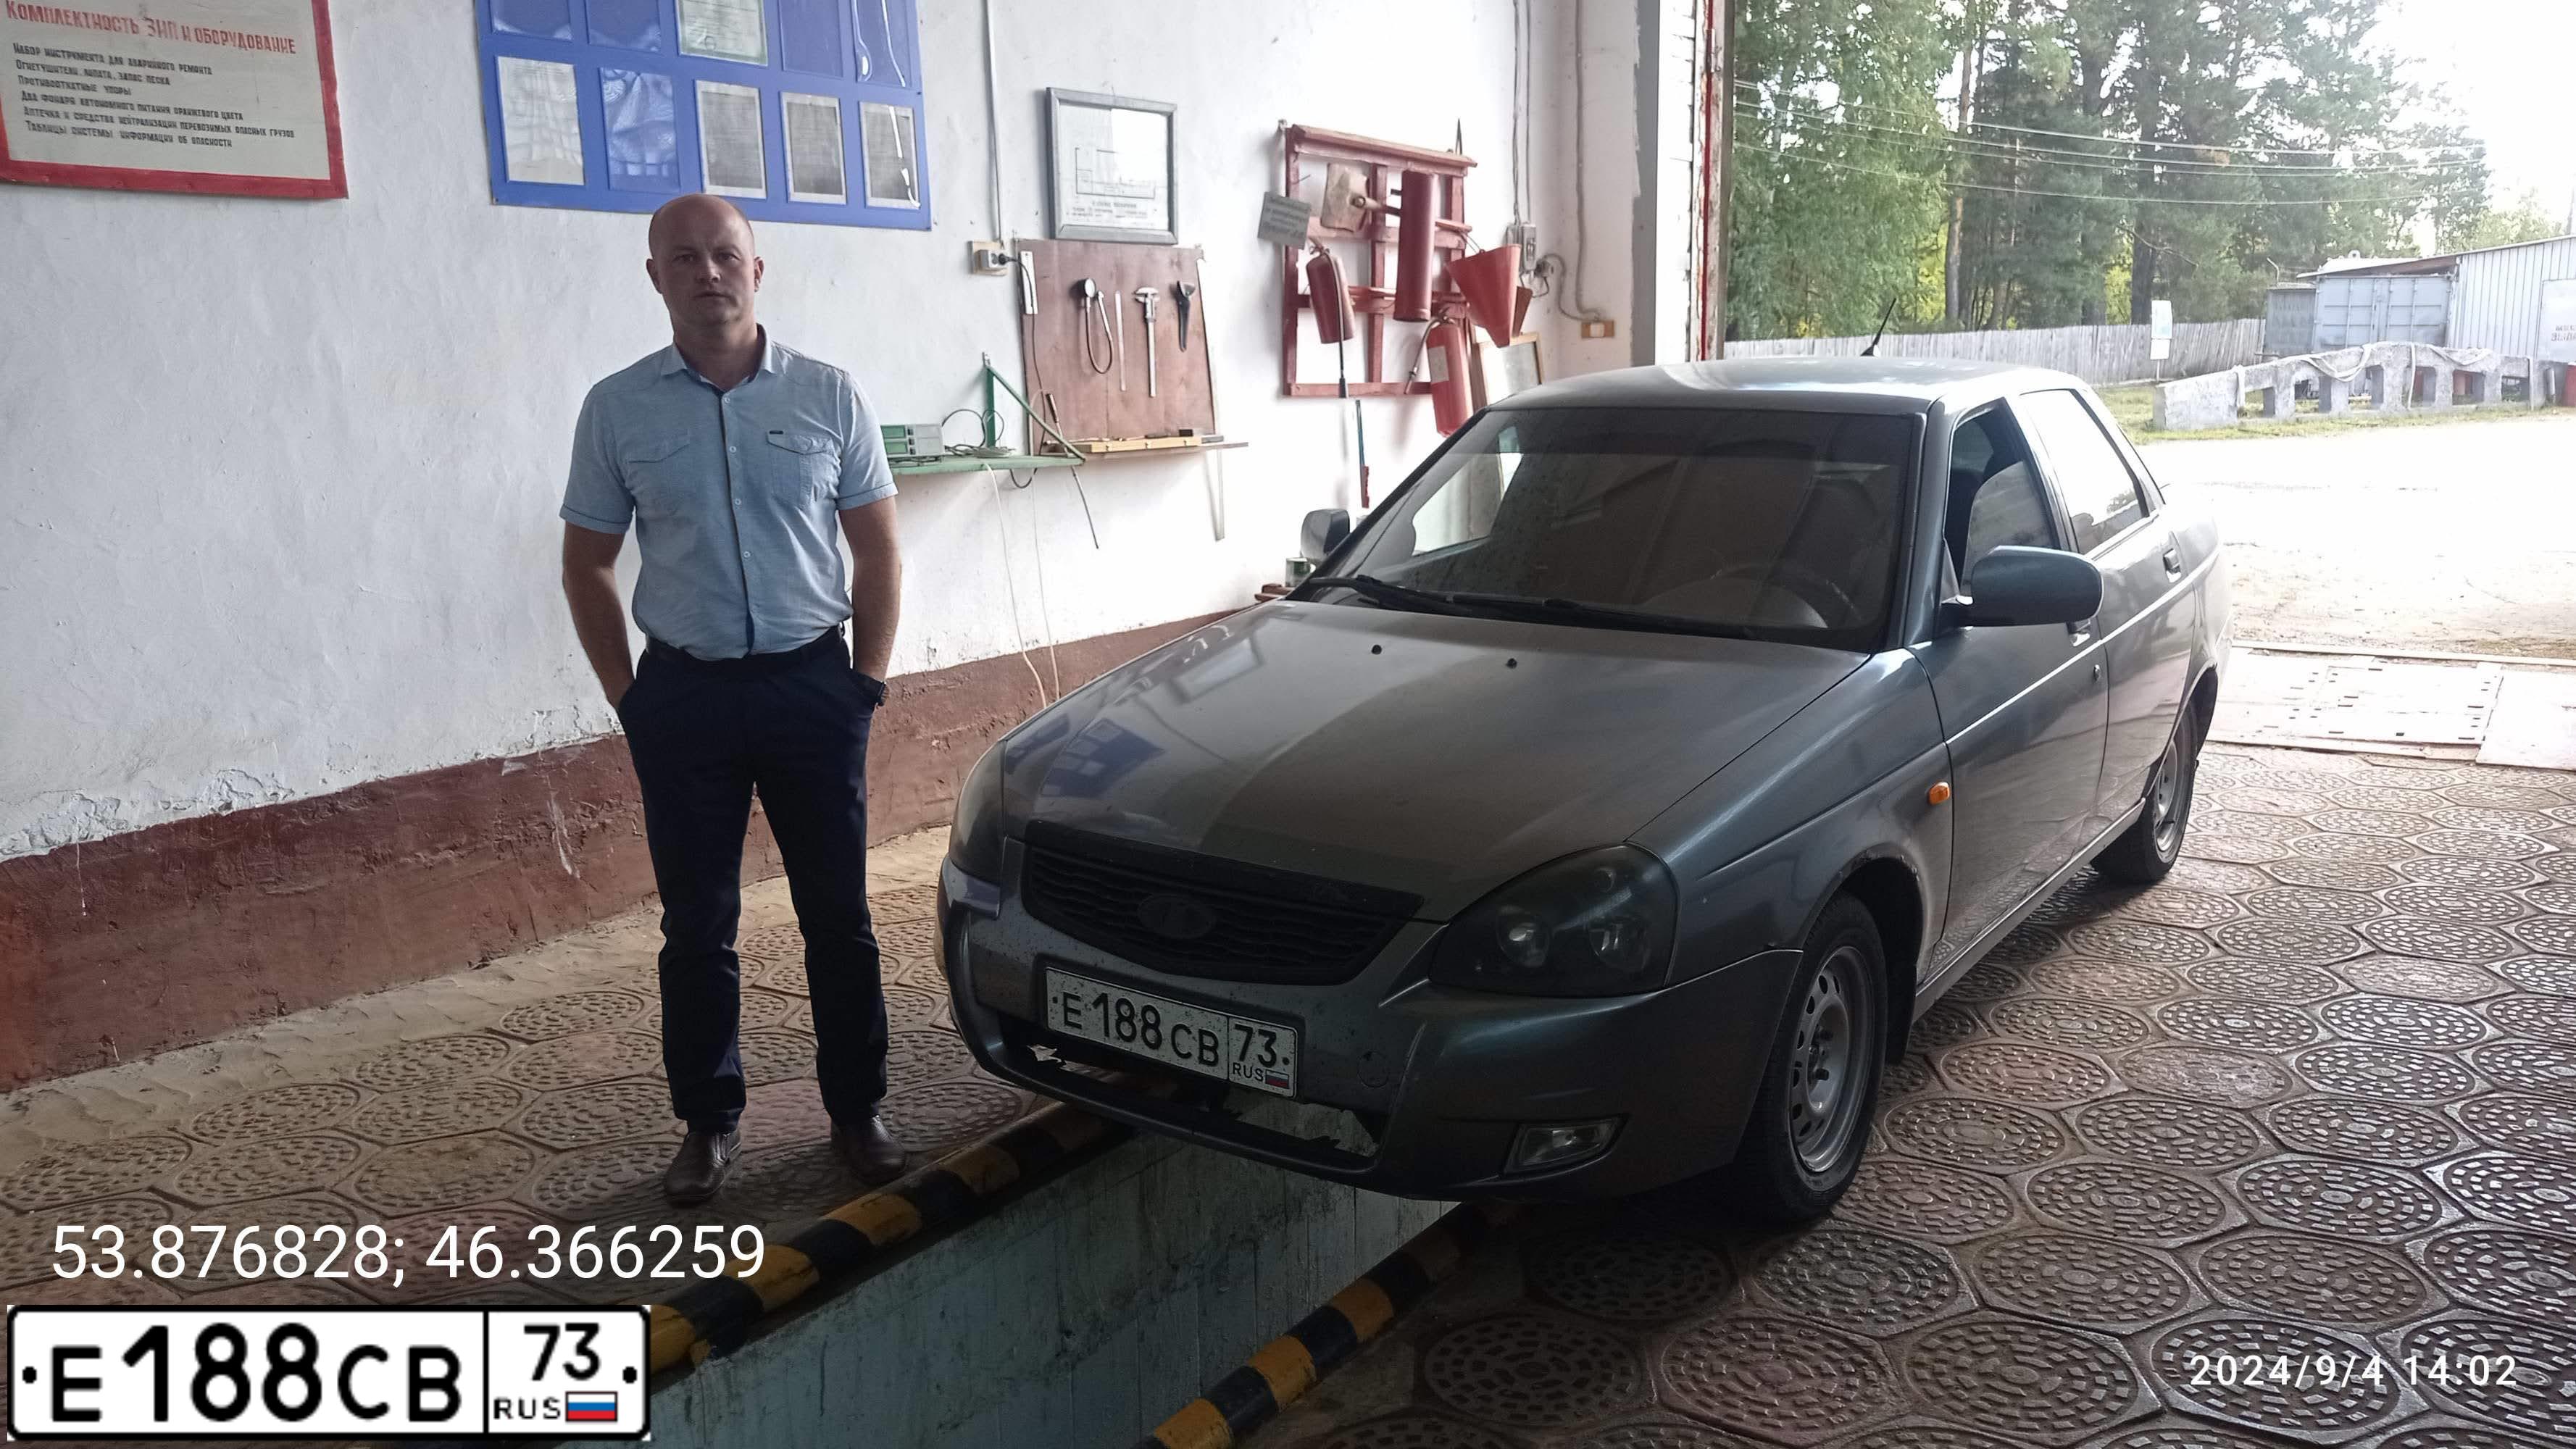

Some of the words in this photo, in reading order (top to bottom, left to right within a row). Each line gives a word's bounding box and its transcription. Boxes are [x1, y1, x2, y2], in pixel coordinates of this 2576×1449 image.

[195, 28, 296, 54] ОБОРУДОВАНИЕ
[1234, 1024, 1277, 1068] 73
[1232, 1062, 1264, 1082] RUS
